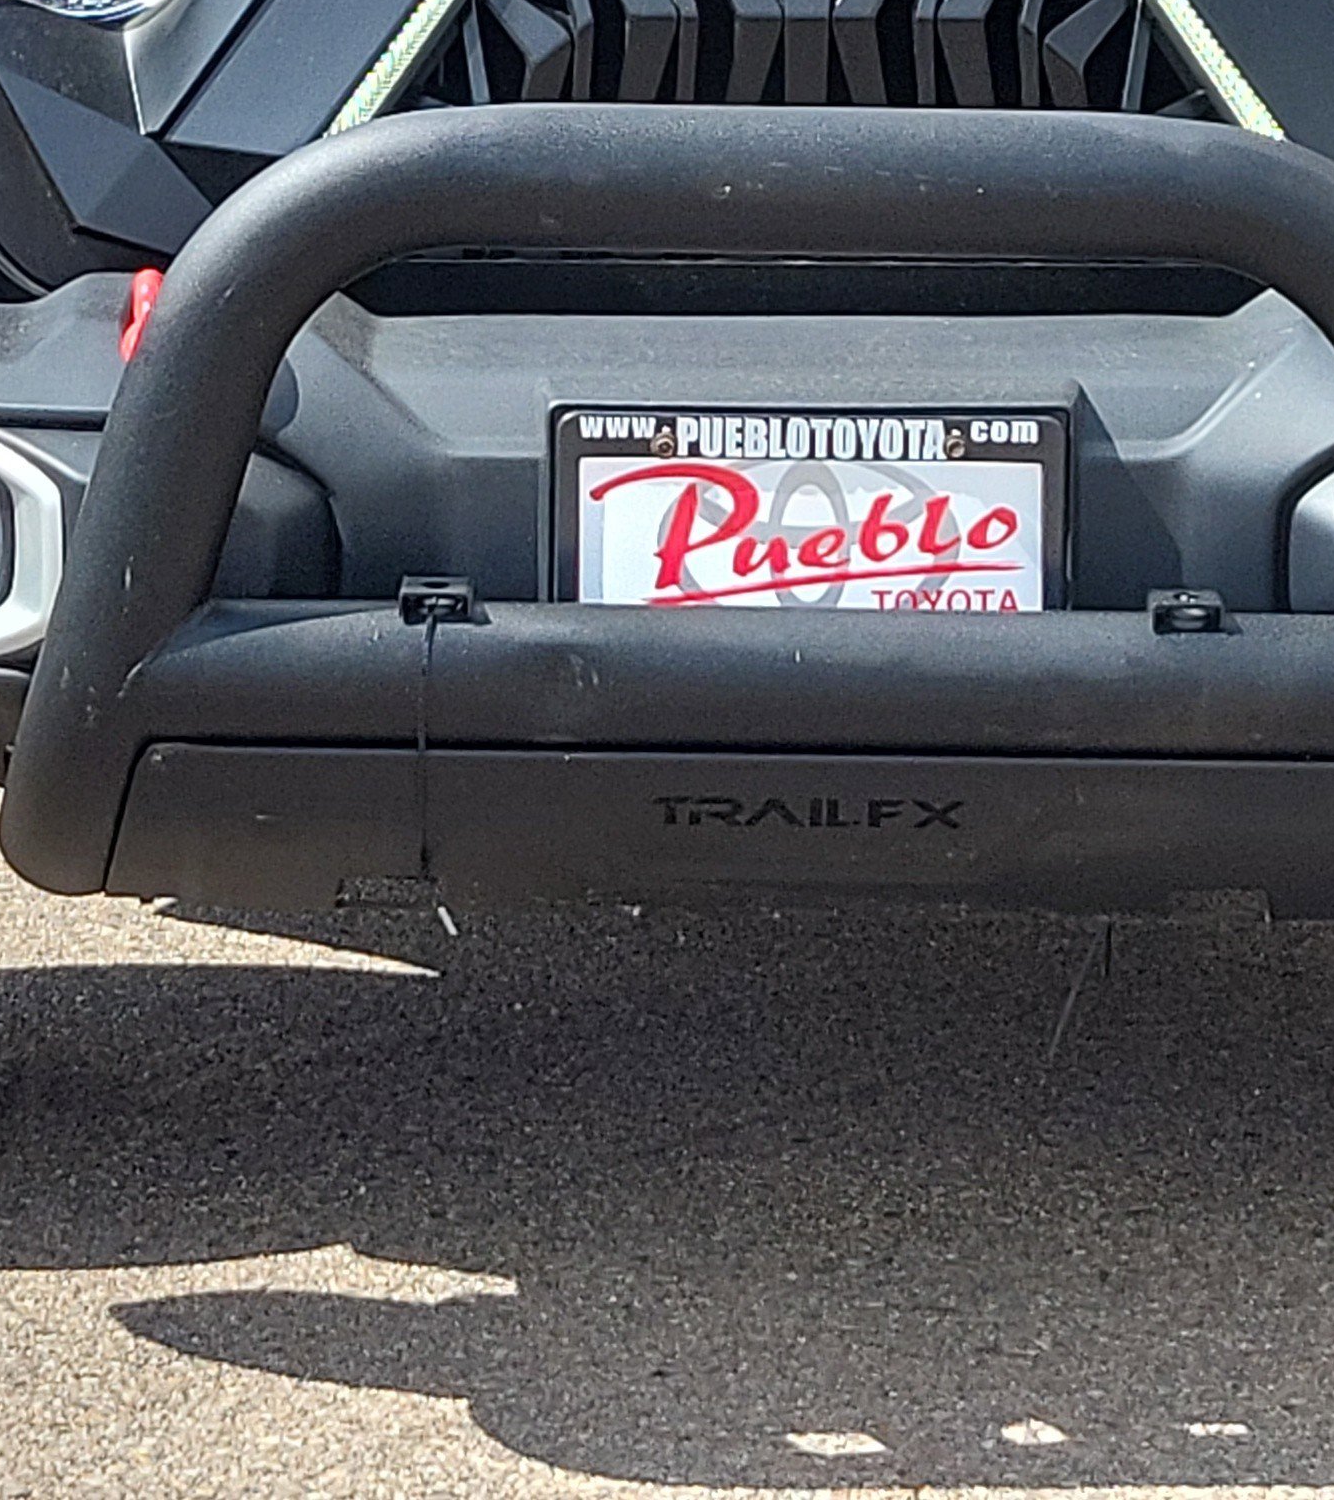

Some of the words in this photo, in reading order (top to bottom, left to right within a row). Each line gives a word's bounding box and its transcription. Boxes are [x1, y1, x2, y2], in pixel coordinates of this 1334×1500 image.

[589, 463, 1019, 590] Pueblo
[870, 588, 1020, 613] TOYOTA
[652, 796, 965, 828] TRAILFX
